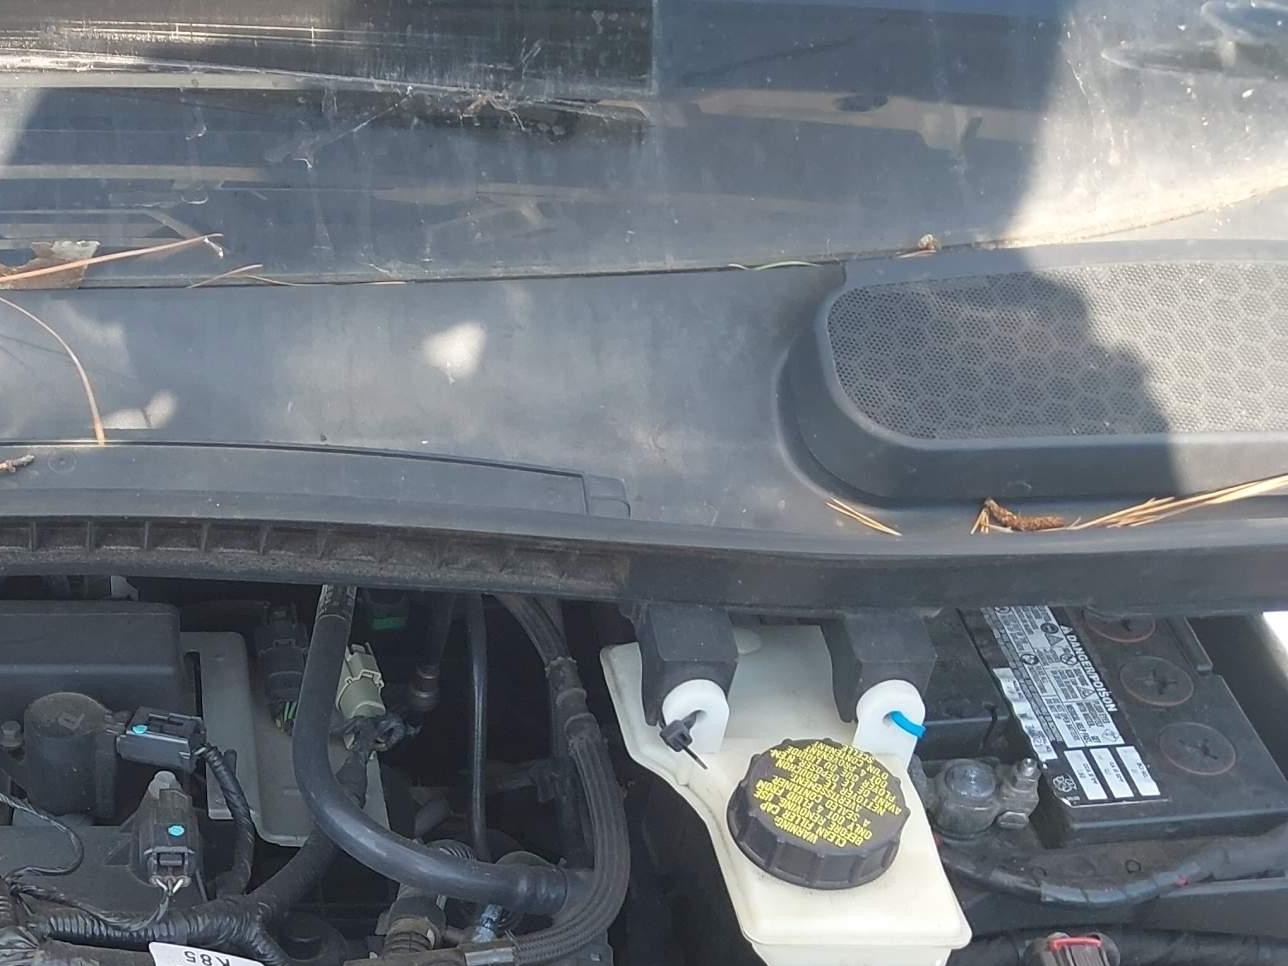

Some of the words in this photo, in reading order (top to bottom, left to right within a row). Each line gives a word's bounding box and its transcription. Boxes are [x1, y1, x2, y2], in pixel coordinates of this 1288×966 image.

[1066, 634, 1118, 712] DANGER/POISON
[784, 746, 822, 764] LIQUIDE
[804, 746, 856, 772] PROVENANT
[775, 757, 819, 782] BOUCHON
[824, 762, 838, 773] DU
[840, 769, 859, 782] QUE
[756, 779, 784, 796] FROM
[823, 778, 837, 790] LE
[841, 778, 855, 791] LE
[862, 779, 896, 802] PLOYER
[869, 775, 888, 789] DOT
[753, 787, 774, 801] USE
[857, 786, 870, 797] DE
[760, 802, 780, 814] CAP
[786, 792, 814, 810] FLUID
[816, 805, 824, 813] 4
[840, 787, 886, 816] NETTOYER
[872, 795, 902, 815] AVANT
[825, 800, 860, 822] SEALED
[825, 811, 845, 825] DOT
[782, 810, 814, 830] FILLER
[863, 818, 871, 827] A
[775, 816, 818, 844] WARNING:
[816, 826, 846, 847] CLEAN
[827, 821, 863, 846] BEFORE
[847, 822, 872, 839] ONLY
